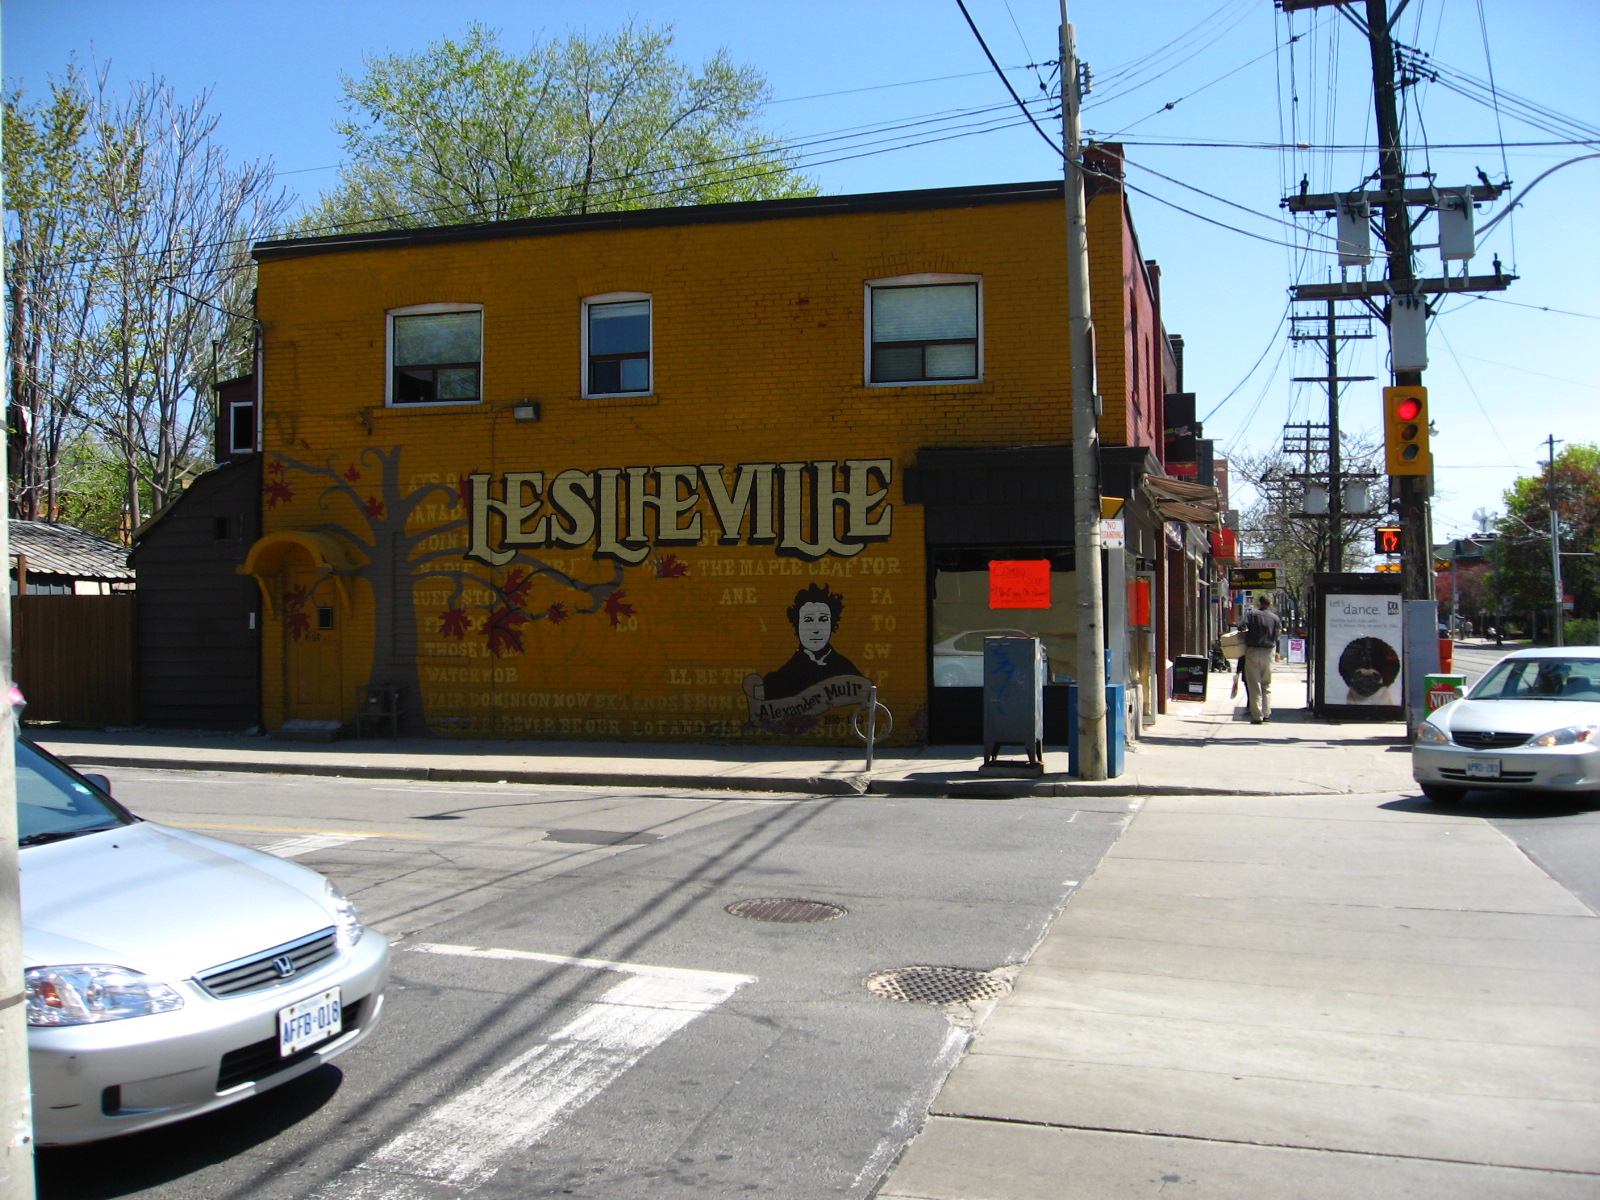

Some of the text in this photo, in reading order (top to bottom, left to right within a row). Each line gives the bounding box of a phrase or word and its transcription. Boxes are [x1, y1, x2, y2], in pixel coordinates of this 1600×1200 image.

[464, 459, 892, 564] LESLIEVILLE
[1107, 522, 1116, 530] NO
[1101, 531, 1123, 539] STANDING
[698, 559, 735, 576] THE
[739, 558, 803, 576] MAPLE
[860, 557, 902, 575] FOR
[1343, 603, 1381, 615] dance.
[424, 643, 477, 658] THOSE
[469, 692, 549, 708] DOMINION
[553, 692, 590, 708] NOW
[757, 692, 823, 721] Alexander
[823, 681, 863, 702] Muir
